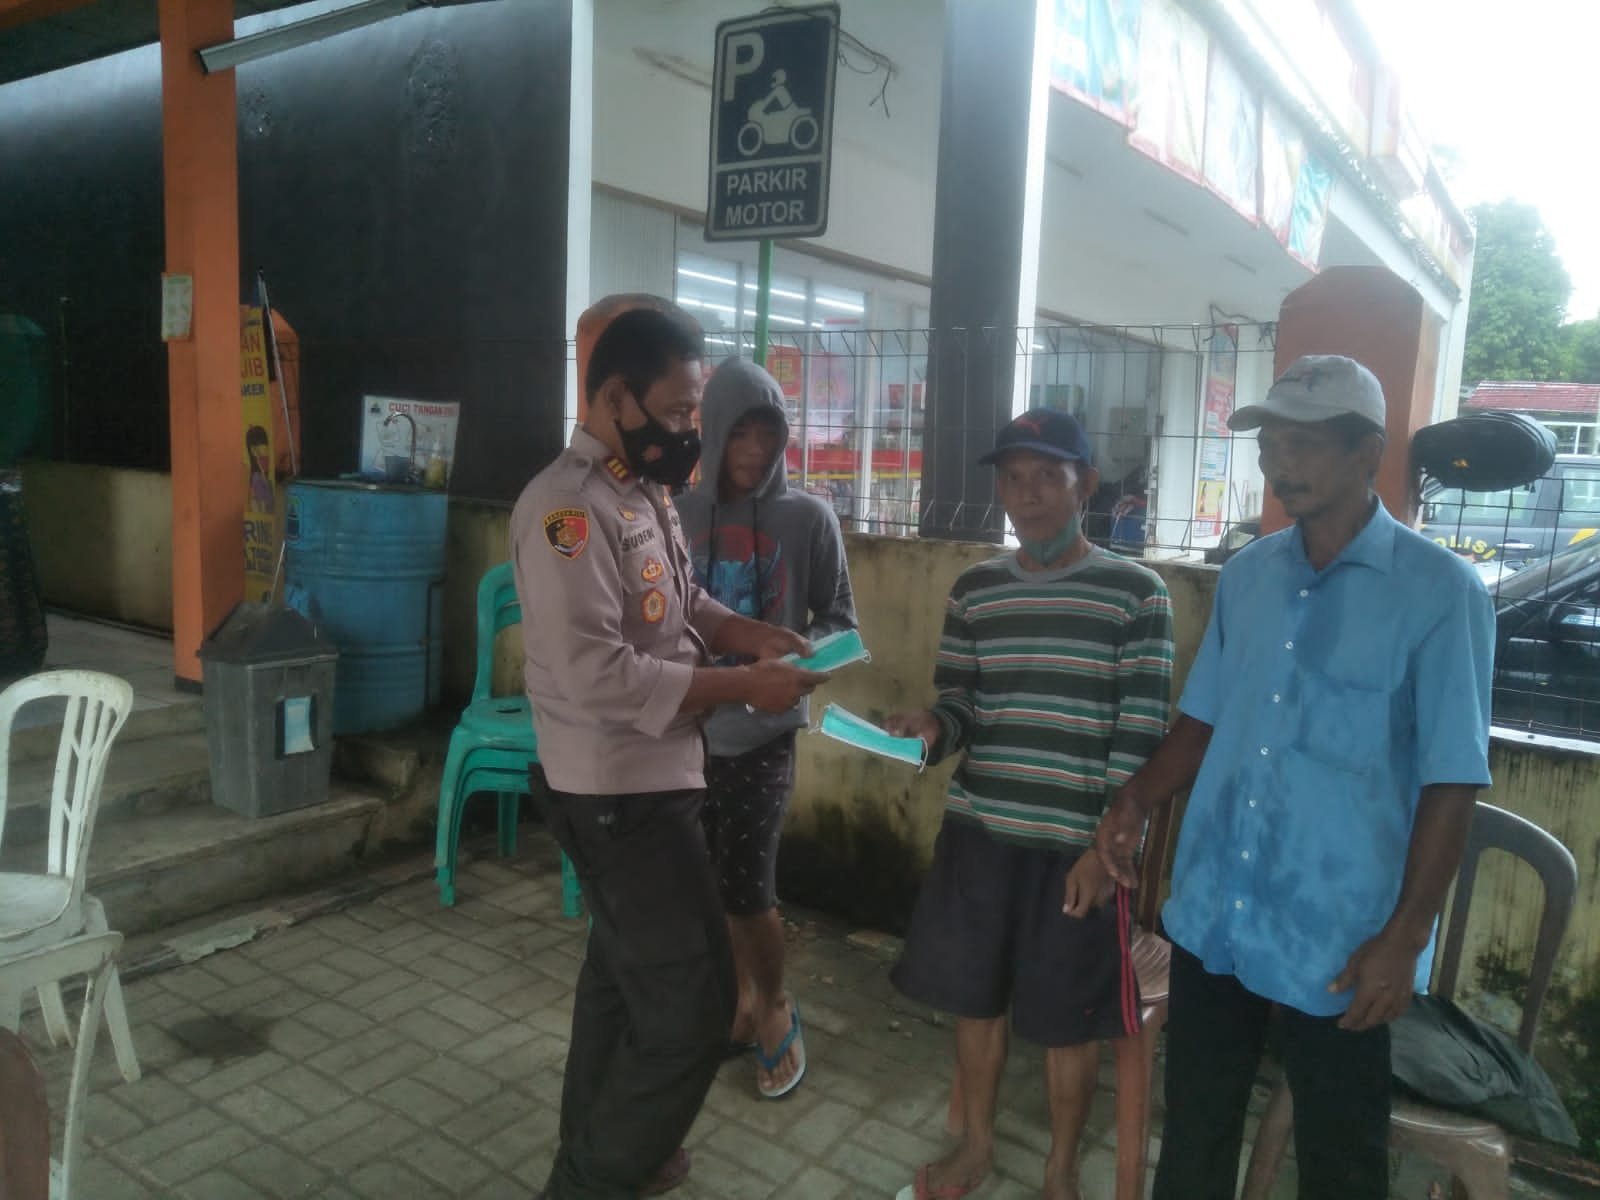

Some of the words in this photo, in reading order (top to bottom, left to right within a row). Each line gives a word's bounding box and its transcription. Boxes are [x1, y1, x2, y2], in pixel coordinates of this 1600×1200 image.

[723, 31, 764, 103] P
[727, 167, 808, 196] PARKIR
[725, 200, 805, 227] MOTOR
